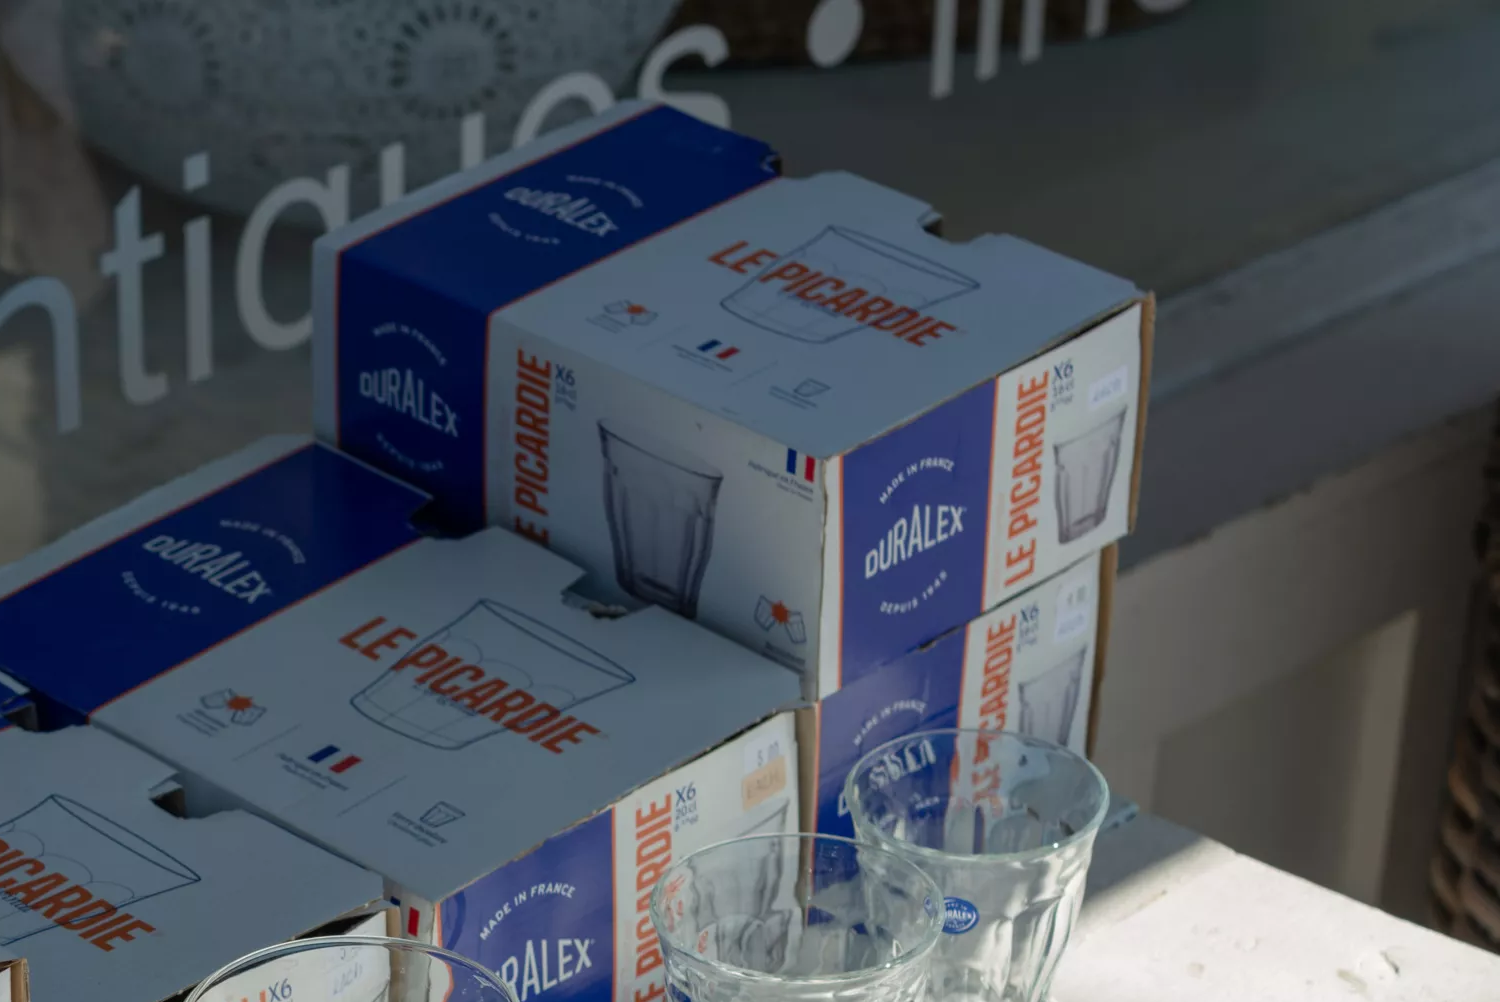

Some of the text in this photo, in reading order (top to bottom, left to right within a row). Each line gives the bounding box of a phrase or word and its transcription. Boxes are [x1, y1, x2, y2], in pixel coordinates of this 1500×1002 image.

[708, 240, 956, 348] LE PICARDIE
[359, 367, 459, 438] DURALEX
[555, 364, 576, 387] X6
[1053, 359, 1074, 381] X6
[514, 347, 551, 520] PICARDIE
[1007, 368, 1049, 540] PICARDIE
[879, 457, 955, 504] MADE IN FRANCE
[141, 534, 271, 604] DURALEX
[865, 504, 964, 580] DURALEX
[1004, 538, 1036, 588] LE
[337, 615, 601, 754] LE PICARDIE
[675, 781, 696, 806] X6
[479, 882, 576, 940] MADE IN FRANCE
[496, 938, 592, 1002] RALEX
